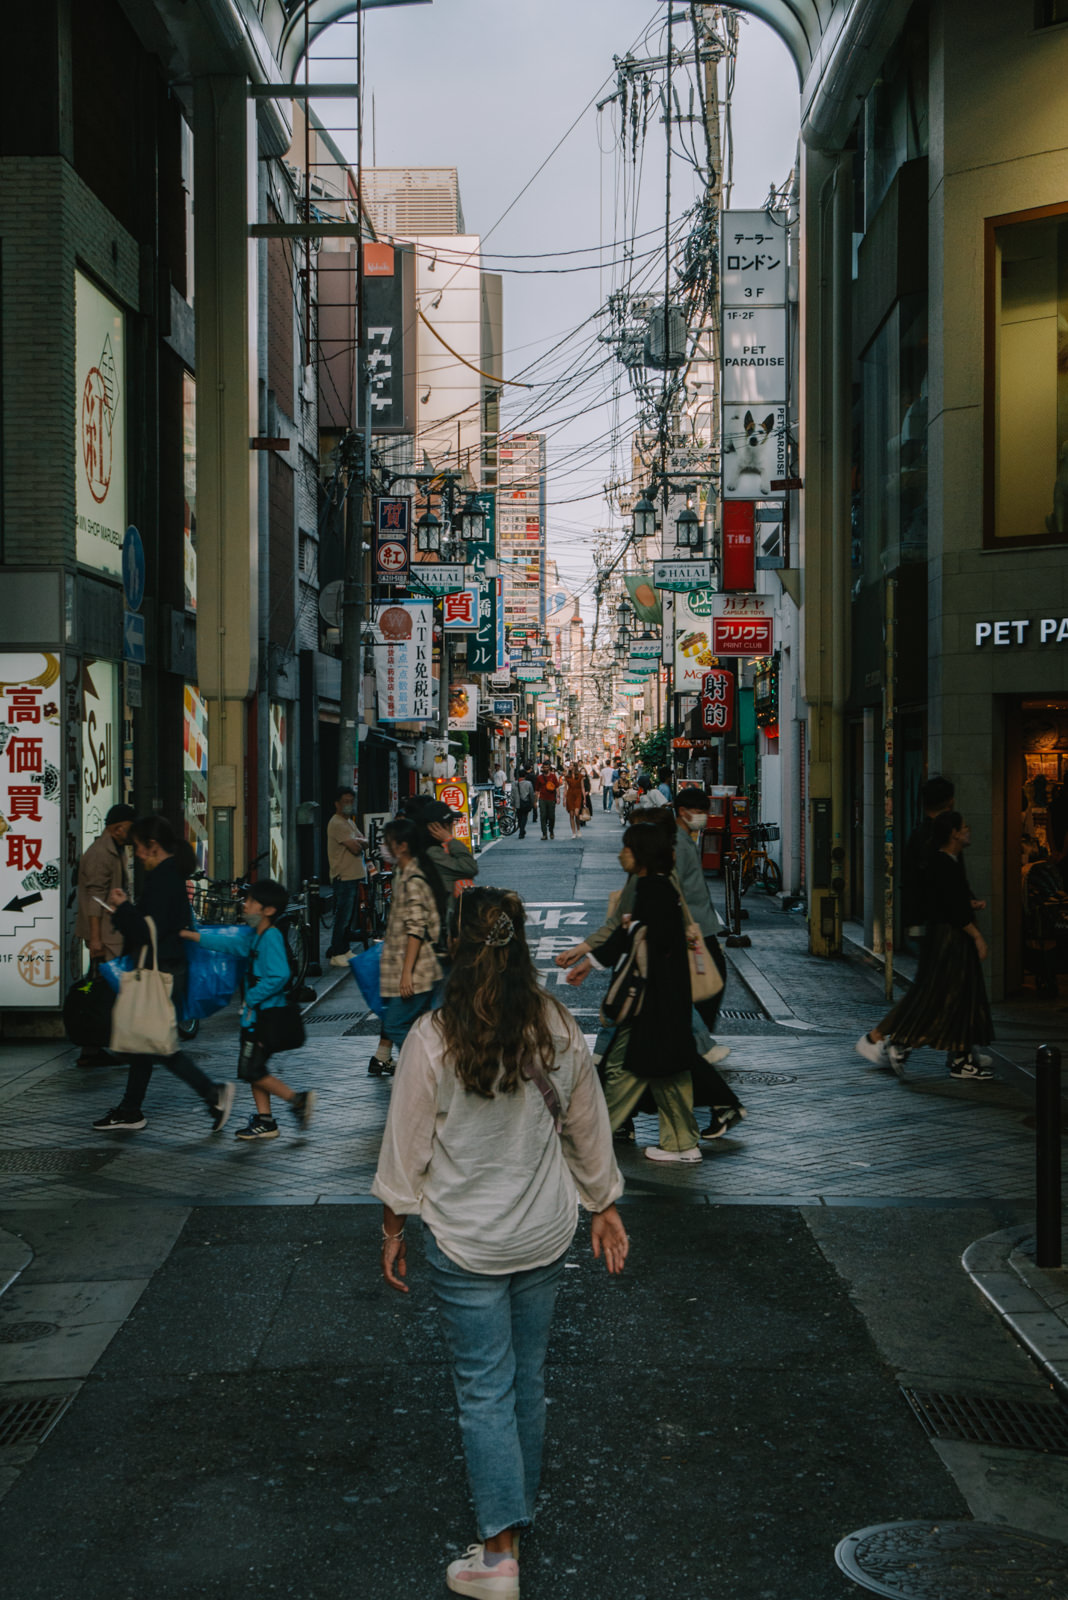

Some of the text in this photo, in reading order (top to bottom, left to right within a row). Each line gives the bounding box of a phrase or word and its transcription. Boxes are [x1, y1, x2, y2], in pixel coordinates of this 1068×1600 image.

[734, 233, 774, 245] テーラー
[727, 254, 781, 271] ロンドン
[743, 345, 767, 355] PET
[725, 357, 785, 367] PARADISE
[776, 407, 785, 422] PET
[383, 547, 402, 566] 紅
[421, 573, 460, 582] HALAL
[669, 568, 708, 578] HALAL
[445, 592, 473, 623] 質
[723, 597, 765, 610] ガチャ
[717, 625, 769, 640] プリクラ
[975, 620, 1029, 646] PET
[704, 674, 728, 727] 射的
[88, 709, 112, 796] Sell
[6, 687, 43, 872] 高価買取
[442, 789, 462, 811] 質
[17, 953, 54, 963] マルベニ
